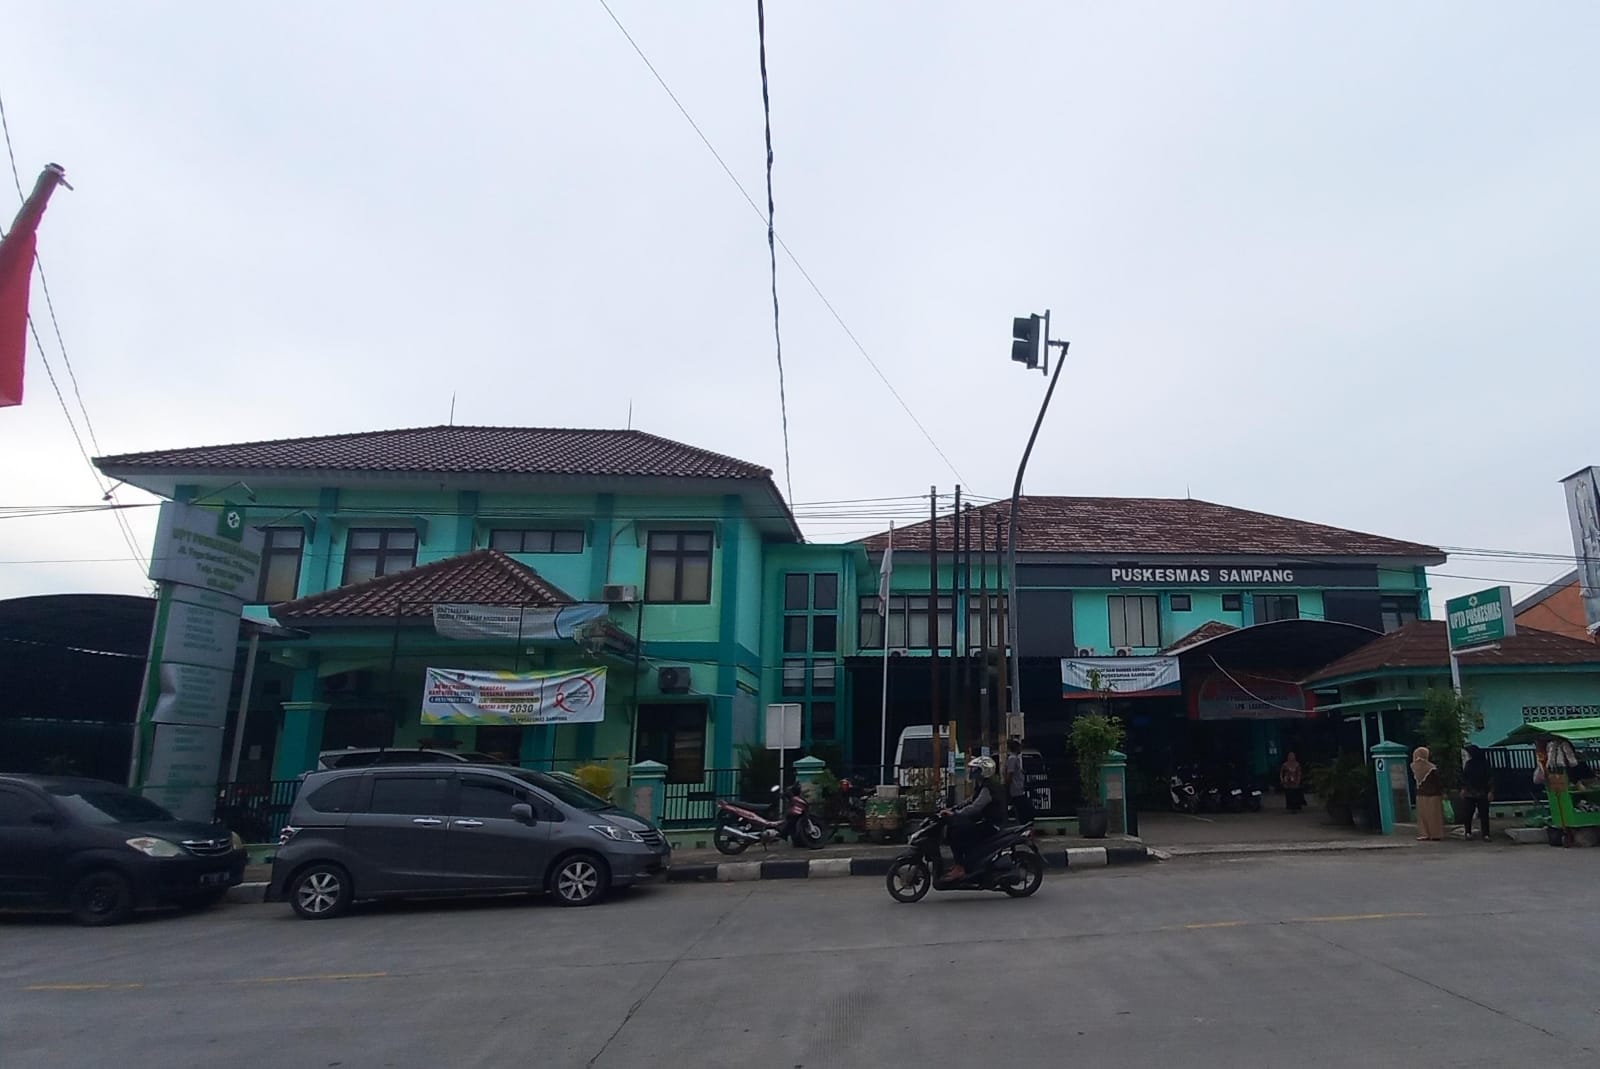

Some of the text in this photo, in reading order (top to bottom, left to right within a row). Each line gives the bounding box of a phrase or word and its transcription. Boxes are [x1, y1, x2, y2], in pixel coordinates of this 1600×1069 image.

[1111, 568, 1294, 582] PUSKESMAS SAMPANG
[1449, 601, 1502, 629] UPTD PUSKESMAS
[509, 704, 534, 713] 2030
